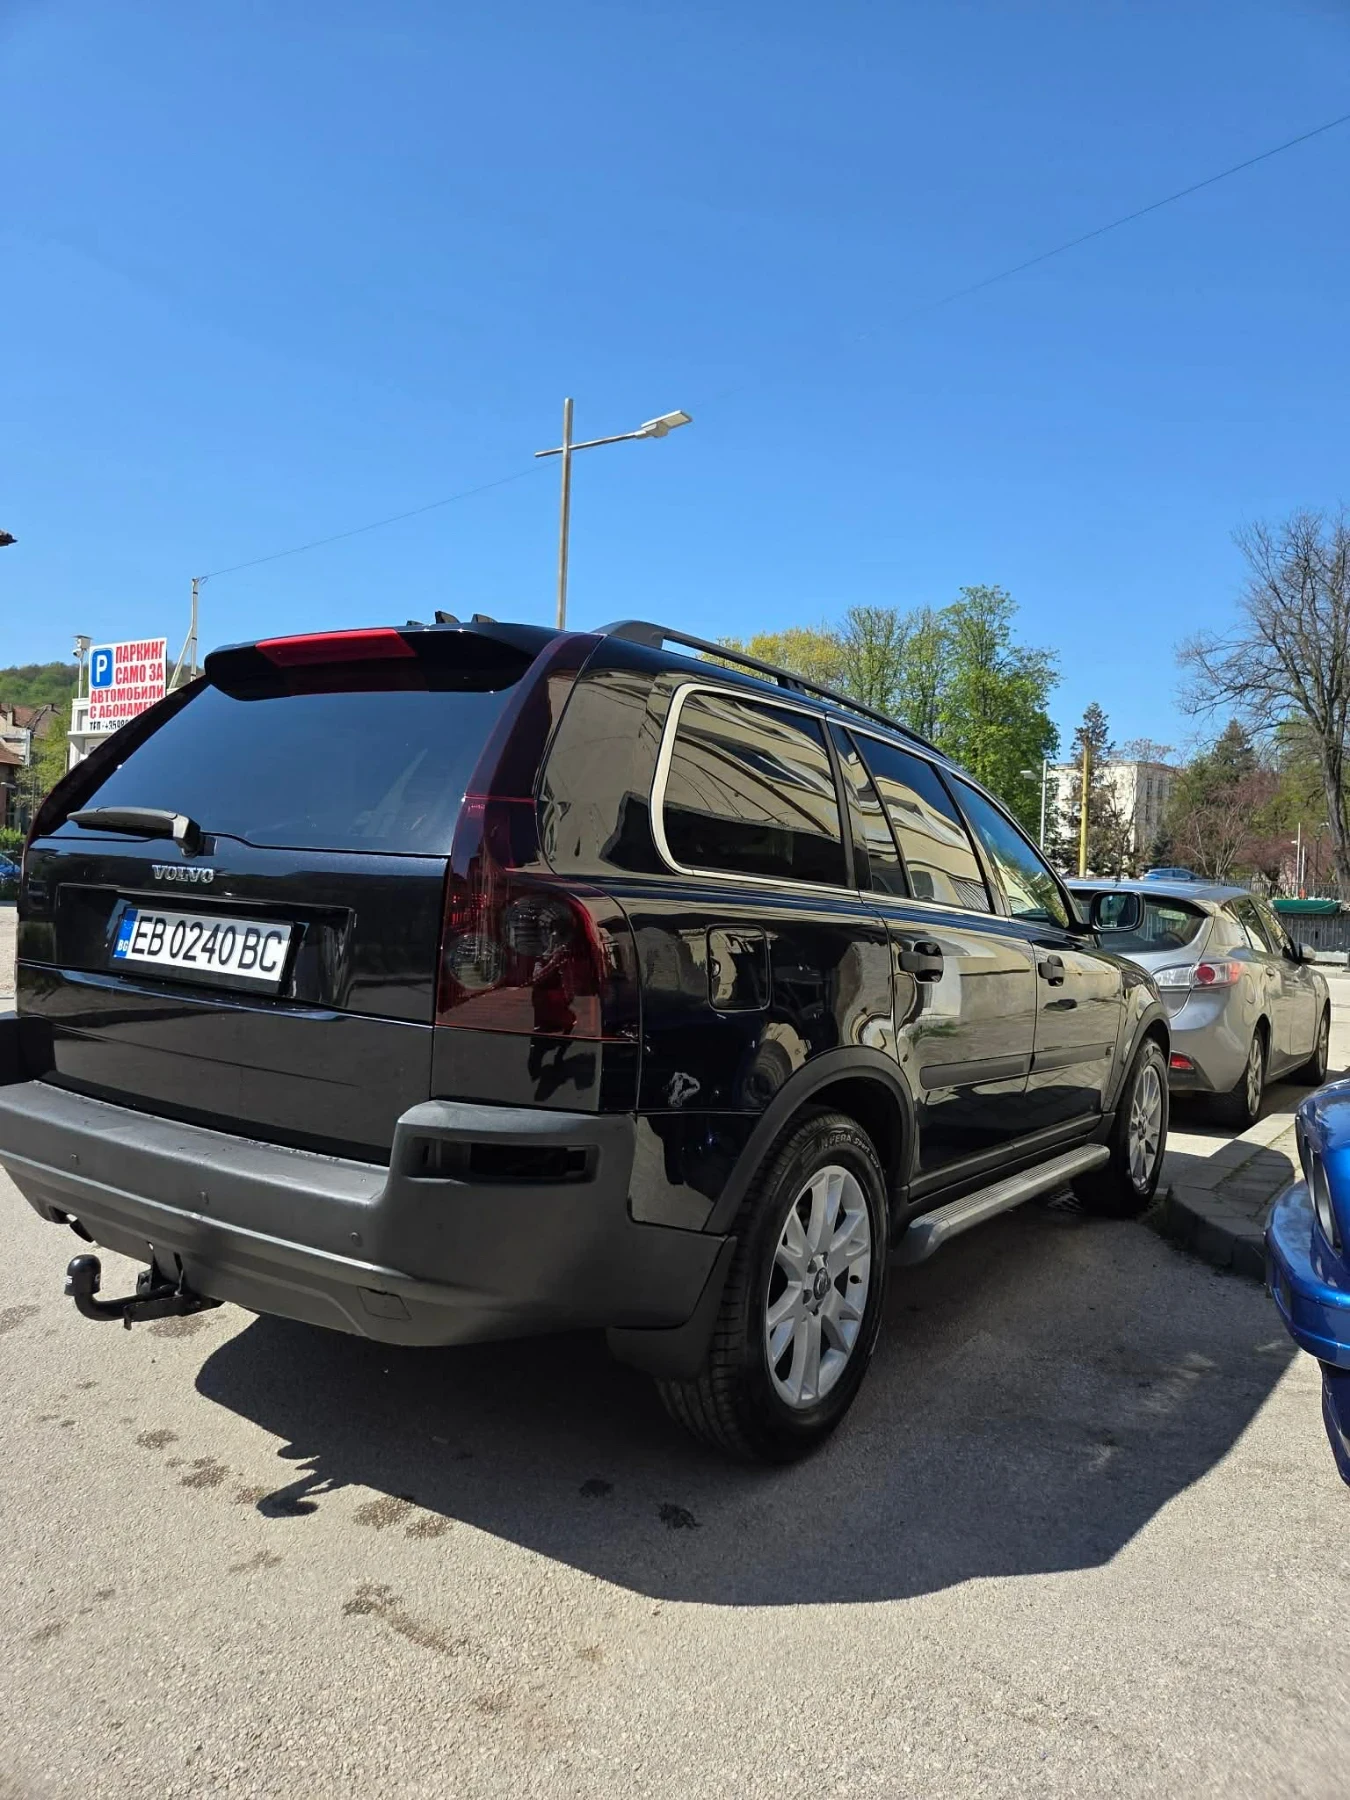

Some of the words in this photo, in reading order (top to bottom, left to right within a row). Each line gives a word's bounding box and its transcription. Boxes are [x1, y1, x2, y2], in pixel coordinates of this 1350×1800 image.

[115, 641, 164, 663] ПАРКИНГ
[96, 654, 107, 683] P
[115, 664, 146, 685] САМО
[149, 663, 163, 681] ЗА
[90, 685, 164, 704] АВТОМОБИЛИ
[89, 705, 97, 719] С
[151, 864, 214, 883] VOLVO
[118, 939, 129, 951] BG
